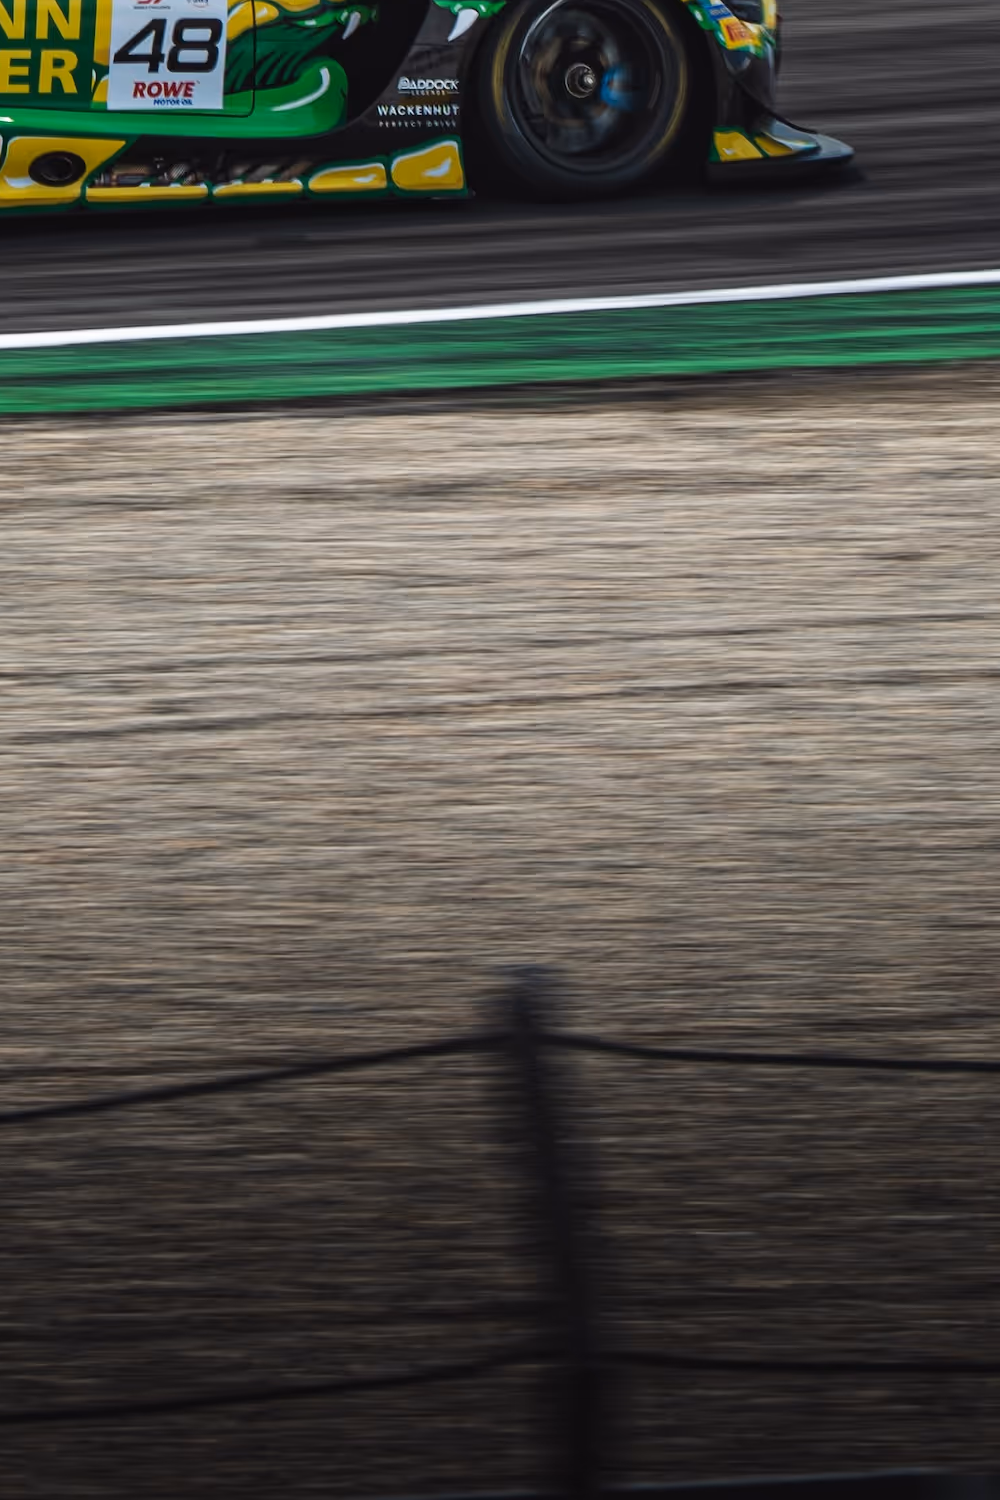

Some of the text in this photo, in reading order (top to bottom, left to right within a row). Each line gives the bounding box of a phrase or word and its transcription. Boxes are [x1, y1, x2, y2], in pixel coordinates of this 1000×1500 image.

[112, 17, 224, 74] 48
[132, 81, 196, 99] ROWE
[397, 76, 460, 90] PADDOCK
[377, 104, 460, 116] WACKENHUT
